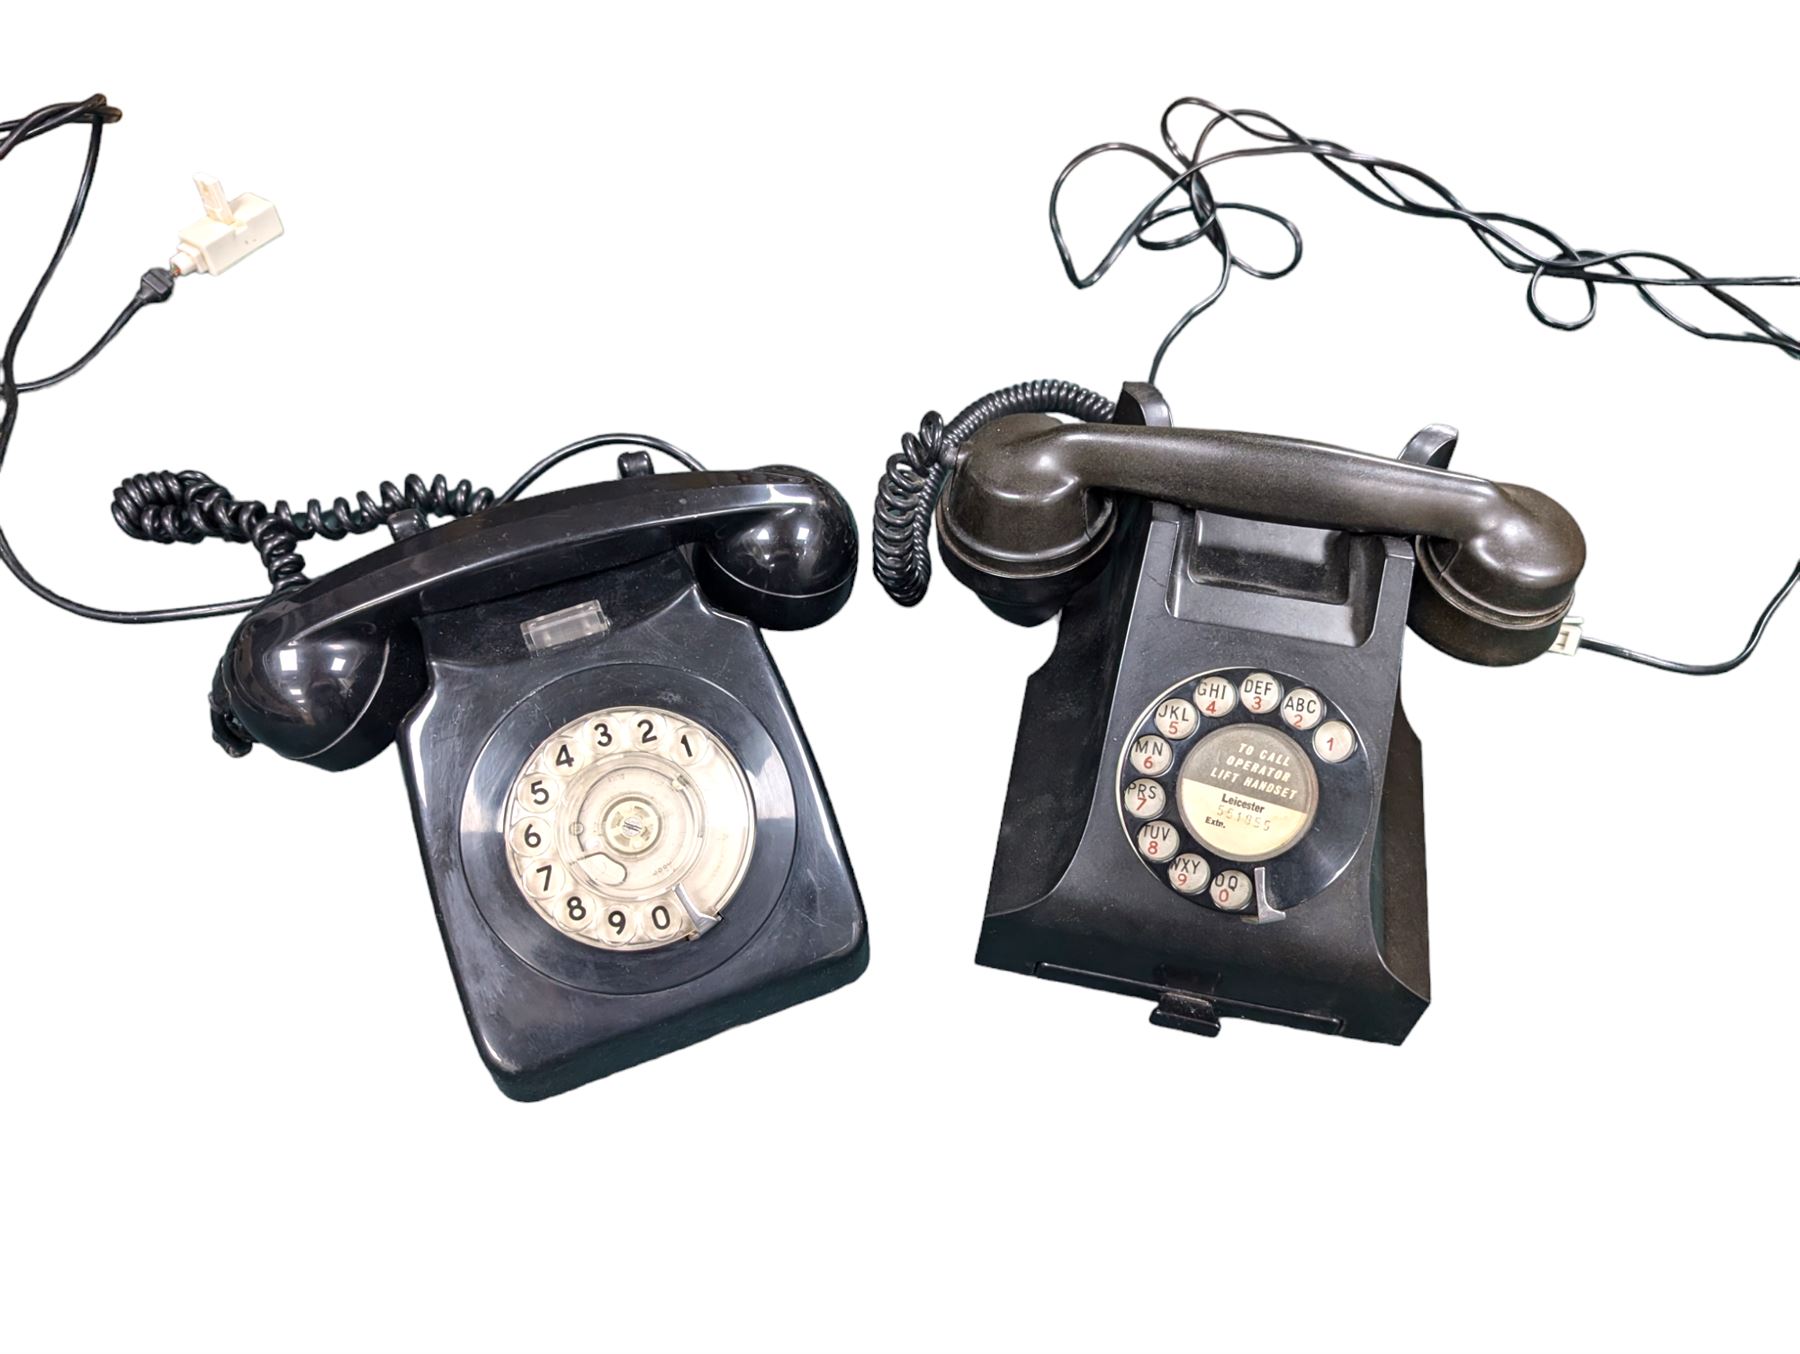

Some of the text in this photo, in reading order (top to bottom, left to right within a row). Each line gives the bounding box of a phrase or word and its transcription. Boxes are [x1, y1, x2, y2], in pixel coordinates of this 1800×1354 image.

[1197, 681, 1227, 700] GHI
[1244, 679, 1273, 696] DEF
[1206, 700, 1216, 714] 4
[1252, 696, 1262, 710] 3
[1285, 696, 1317, 714] ABC
[1158, 704, 1189, 722] JKL
[1294, 714, 1303, 728] 2
[594, 723, 612, 747] 3
[637, 720, 657, 744] 2
[1168, 721, 1178, 735] 5
[680, 735, 693, 757] 1
[1135, 740, 1164, 757] MN
[1327, 737, 1334, 751] 1
[556, 744, 574, 767] 4
[1143, 756, 1153, 769] 6
[1238, 743, 1290, 767] TO CALL
[1226, 755, 1292, 783] OPERATOR
[531, 780, 549, 805] 5
[1127, 782, 1157, 799] PRS
[1210, 767, 1298, 800] LIFT HANDSET
[1136, 797, 1147, 811] 7
[1221, 793, 1265, 814] Leicester
[524, 824, 542, 848] 6
[1143, 825, 1170, 842] TUV
[1148, 841, 1159, 855] 8
[536, 865, 552, 891] 7
[1177, 873, 1187, 886] 9
[1219, 888, 1229, 902] 0
[567, 896, 586, 921] 8
[651, 906, 670, 929] 0
[608, 911, 626, 935] 9
